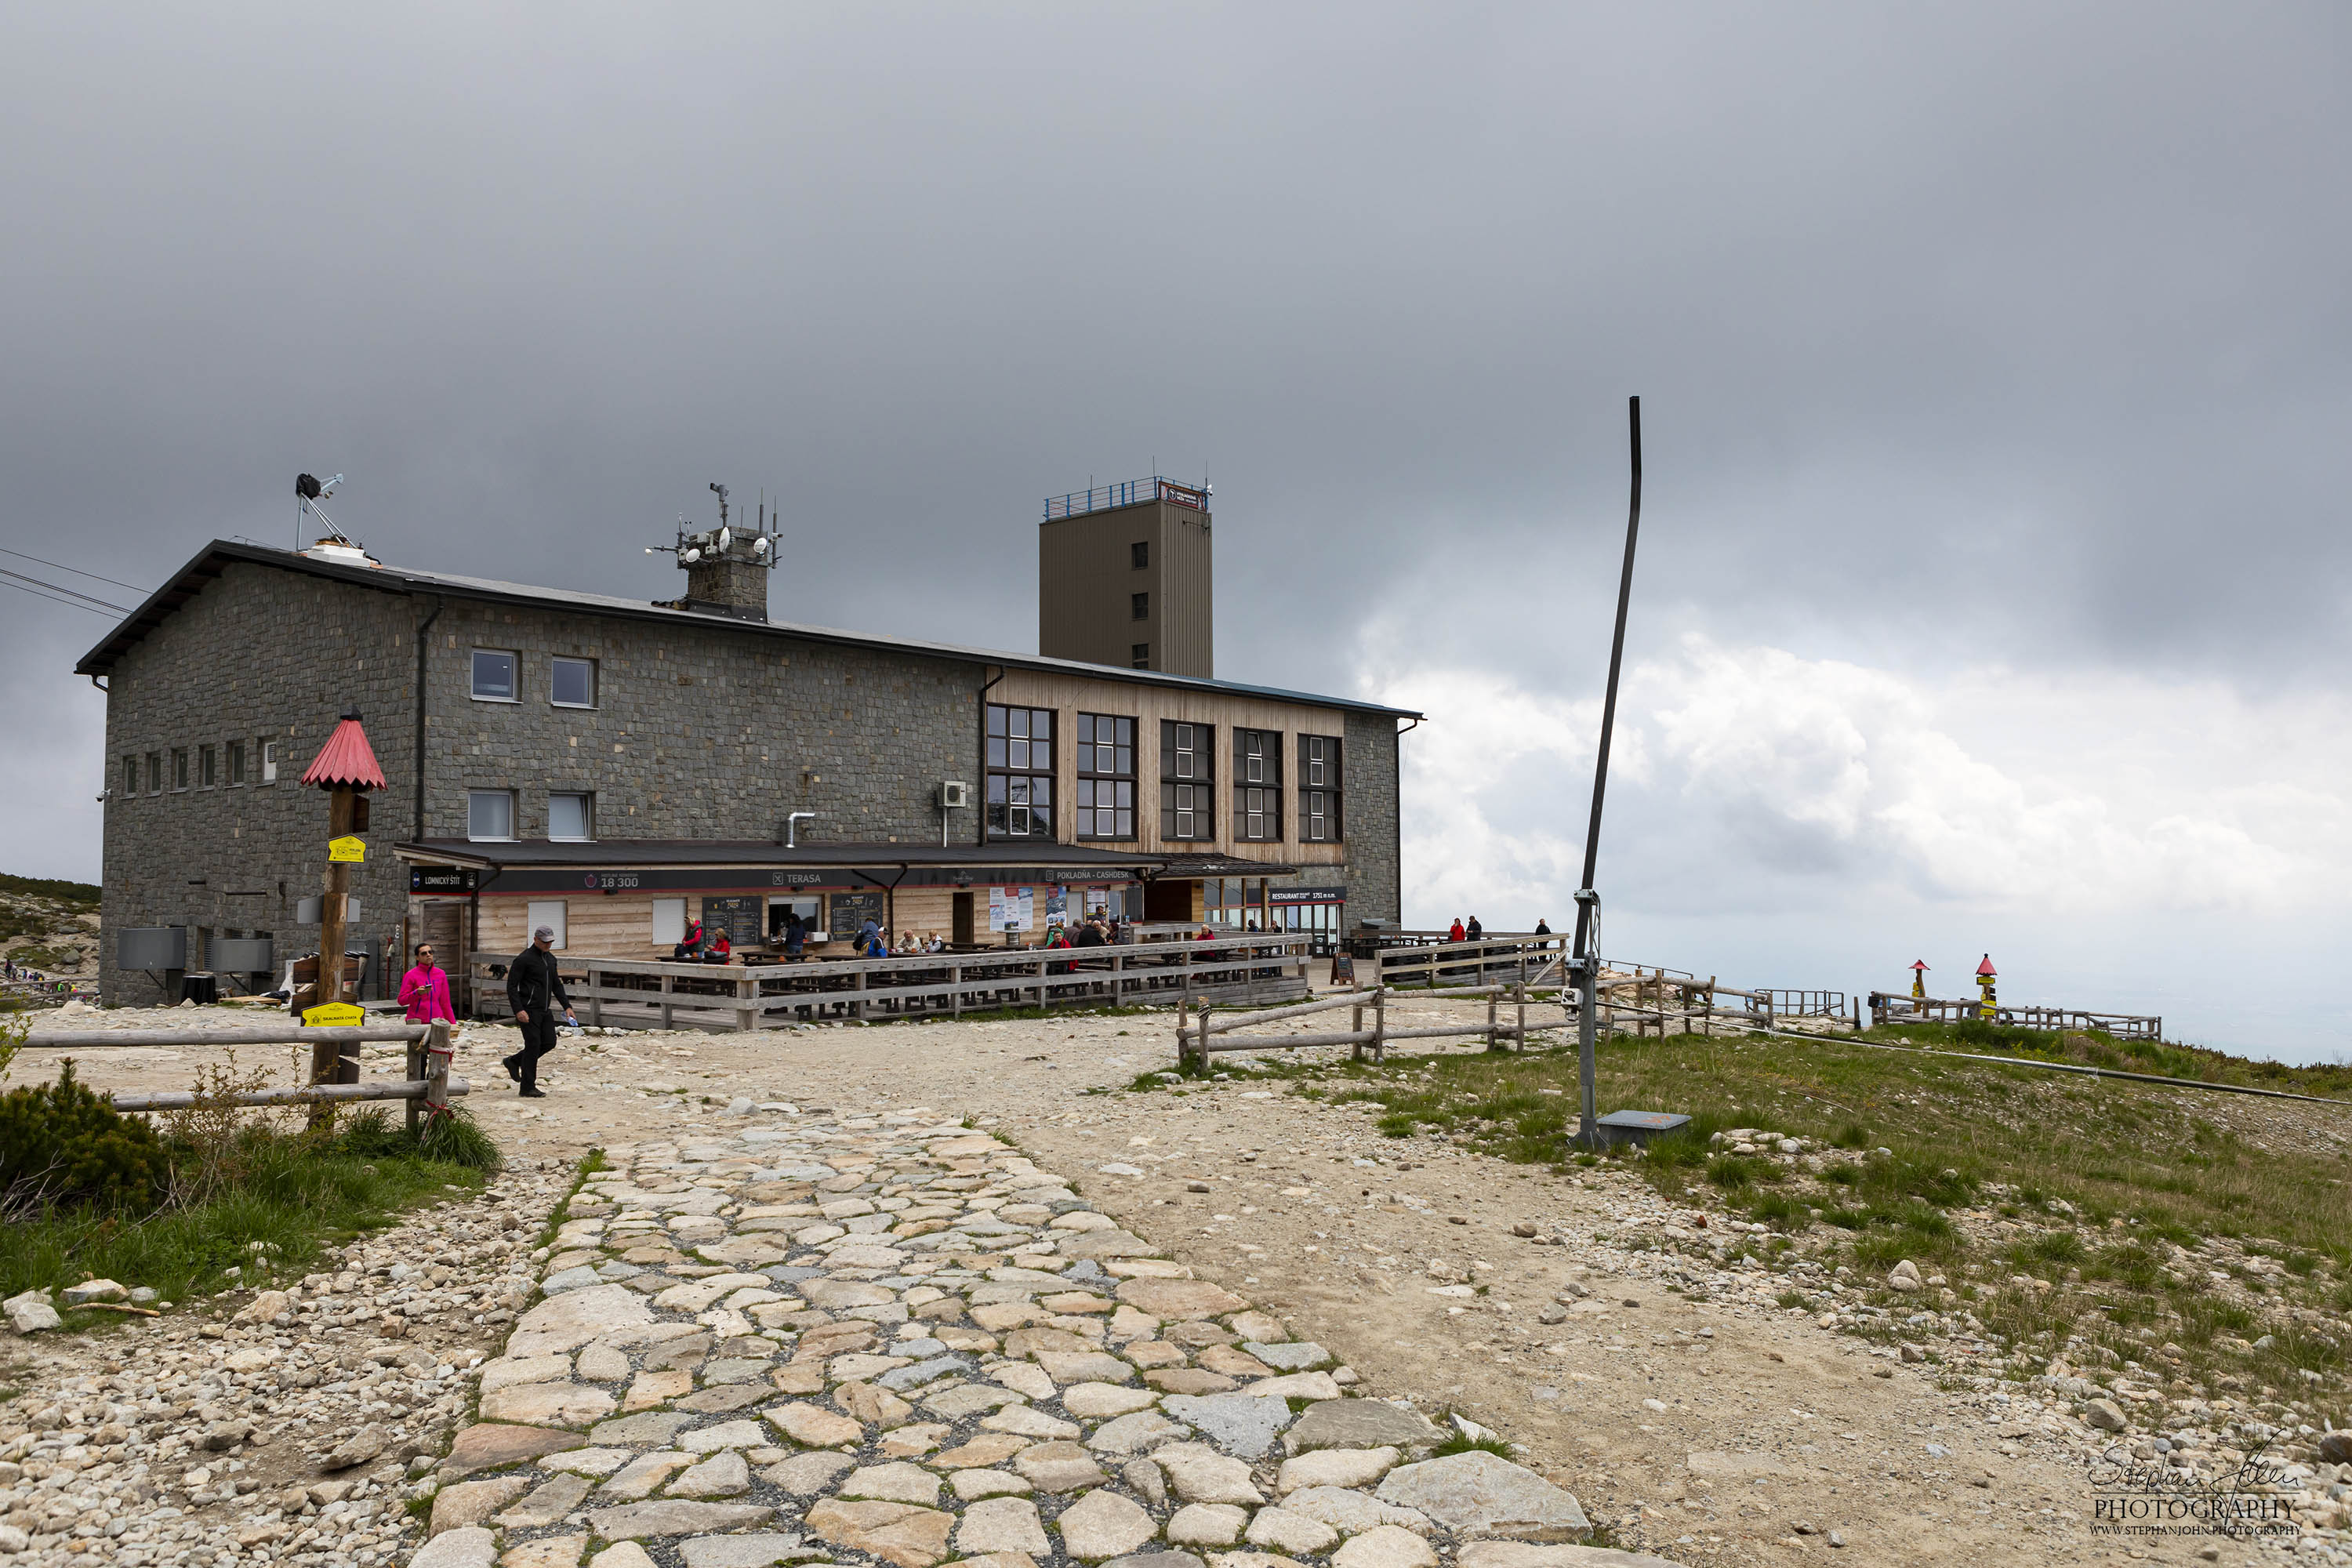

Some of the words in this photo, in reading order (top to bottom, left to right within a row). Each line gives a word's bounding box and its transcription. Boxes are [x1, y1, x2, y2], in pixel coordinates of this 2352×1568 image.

[787, 874, 822, 883] TERASA
[1057, 869, 1091, 879] POKLADŇA
[425, 875, 449, 885] LOMNICKÝ
[450, 874, 460, 885] ŠTÍT
[601, 877, 615, 887] 18
[617, 877, 638, 887] 300
